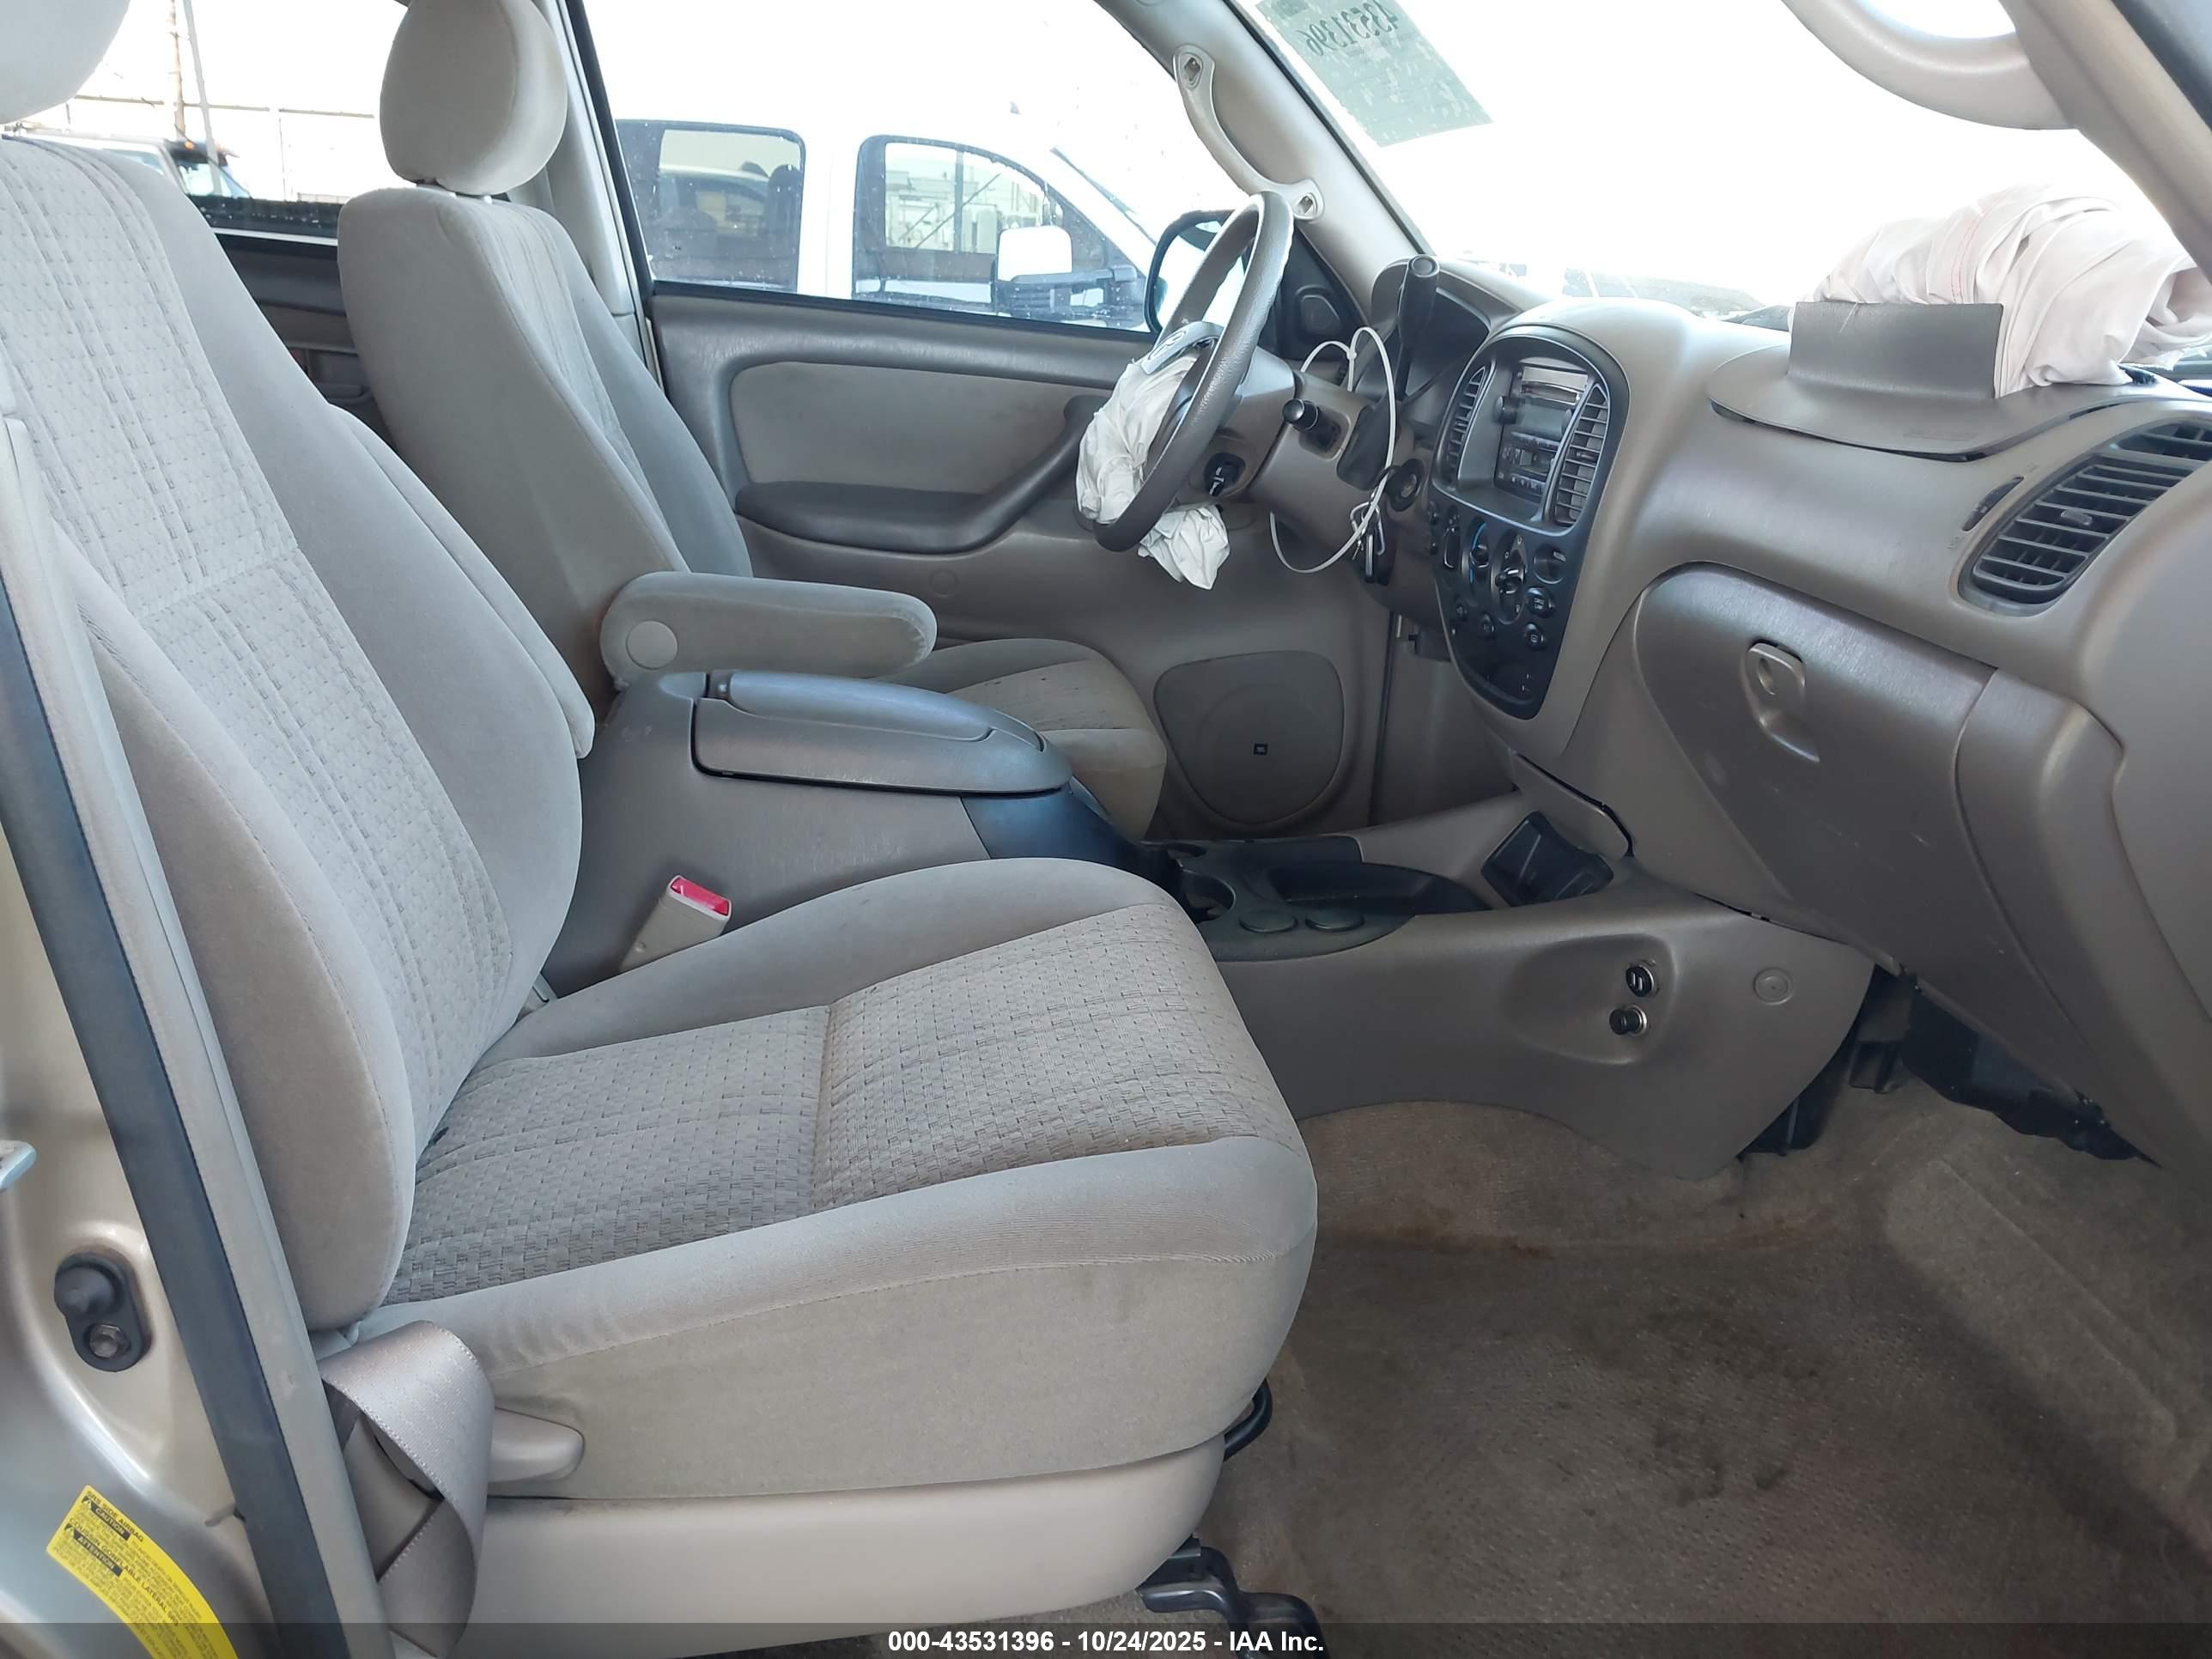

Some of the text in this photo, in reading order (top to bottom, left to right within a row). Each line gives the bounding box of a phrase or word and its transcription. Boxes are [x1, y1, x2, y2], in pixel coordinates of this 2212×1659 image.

[94, 1507, 125, 1534] CAUTION
[102, 1504, 118, 1519] SIDE
[118, 1518, 144, 1542] AIRBAG
[77, 1535, 115, 1571] ATTENTION
[101, 1546, 141, 1583] GONFLABLE
[141, 1582, 167, 1613] LATERAL
